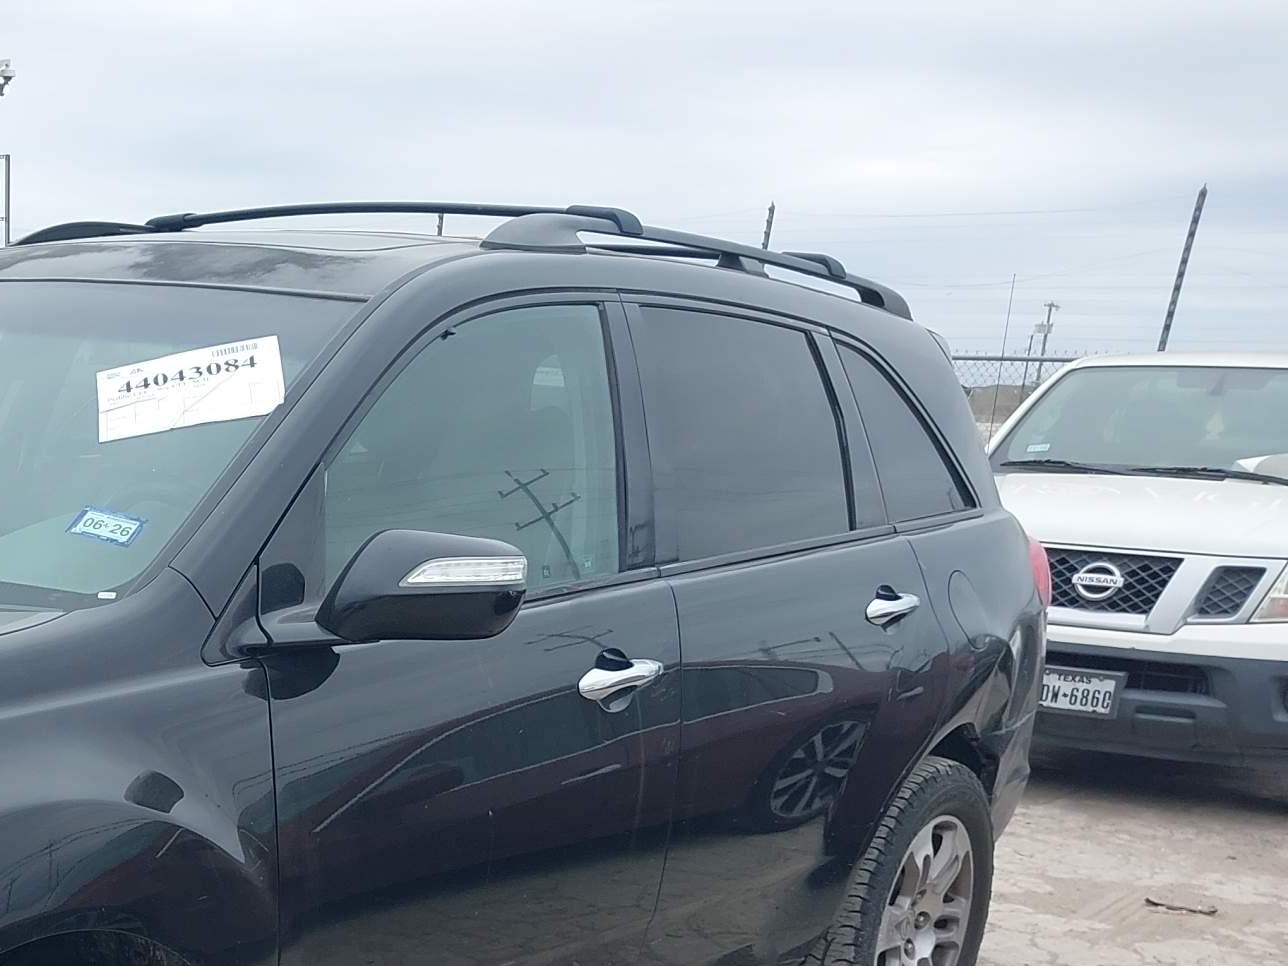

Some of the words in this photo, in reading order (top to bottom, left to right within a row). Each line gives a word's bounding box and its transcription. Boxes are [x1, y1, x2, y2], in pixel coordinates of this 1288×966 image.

[117, 355, 257, 393] 44043084
[1076, 575, 1118, 585] NISSAN
[1056, 673, 1092, 685] TEXAS
